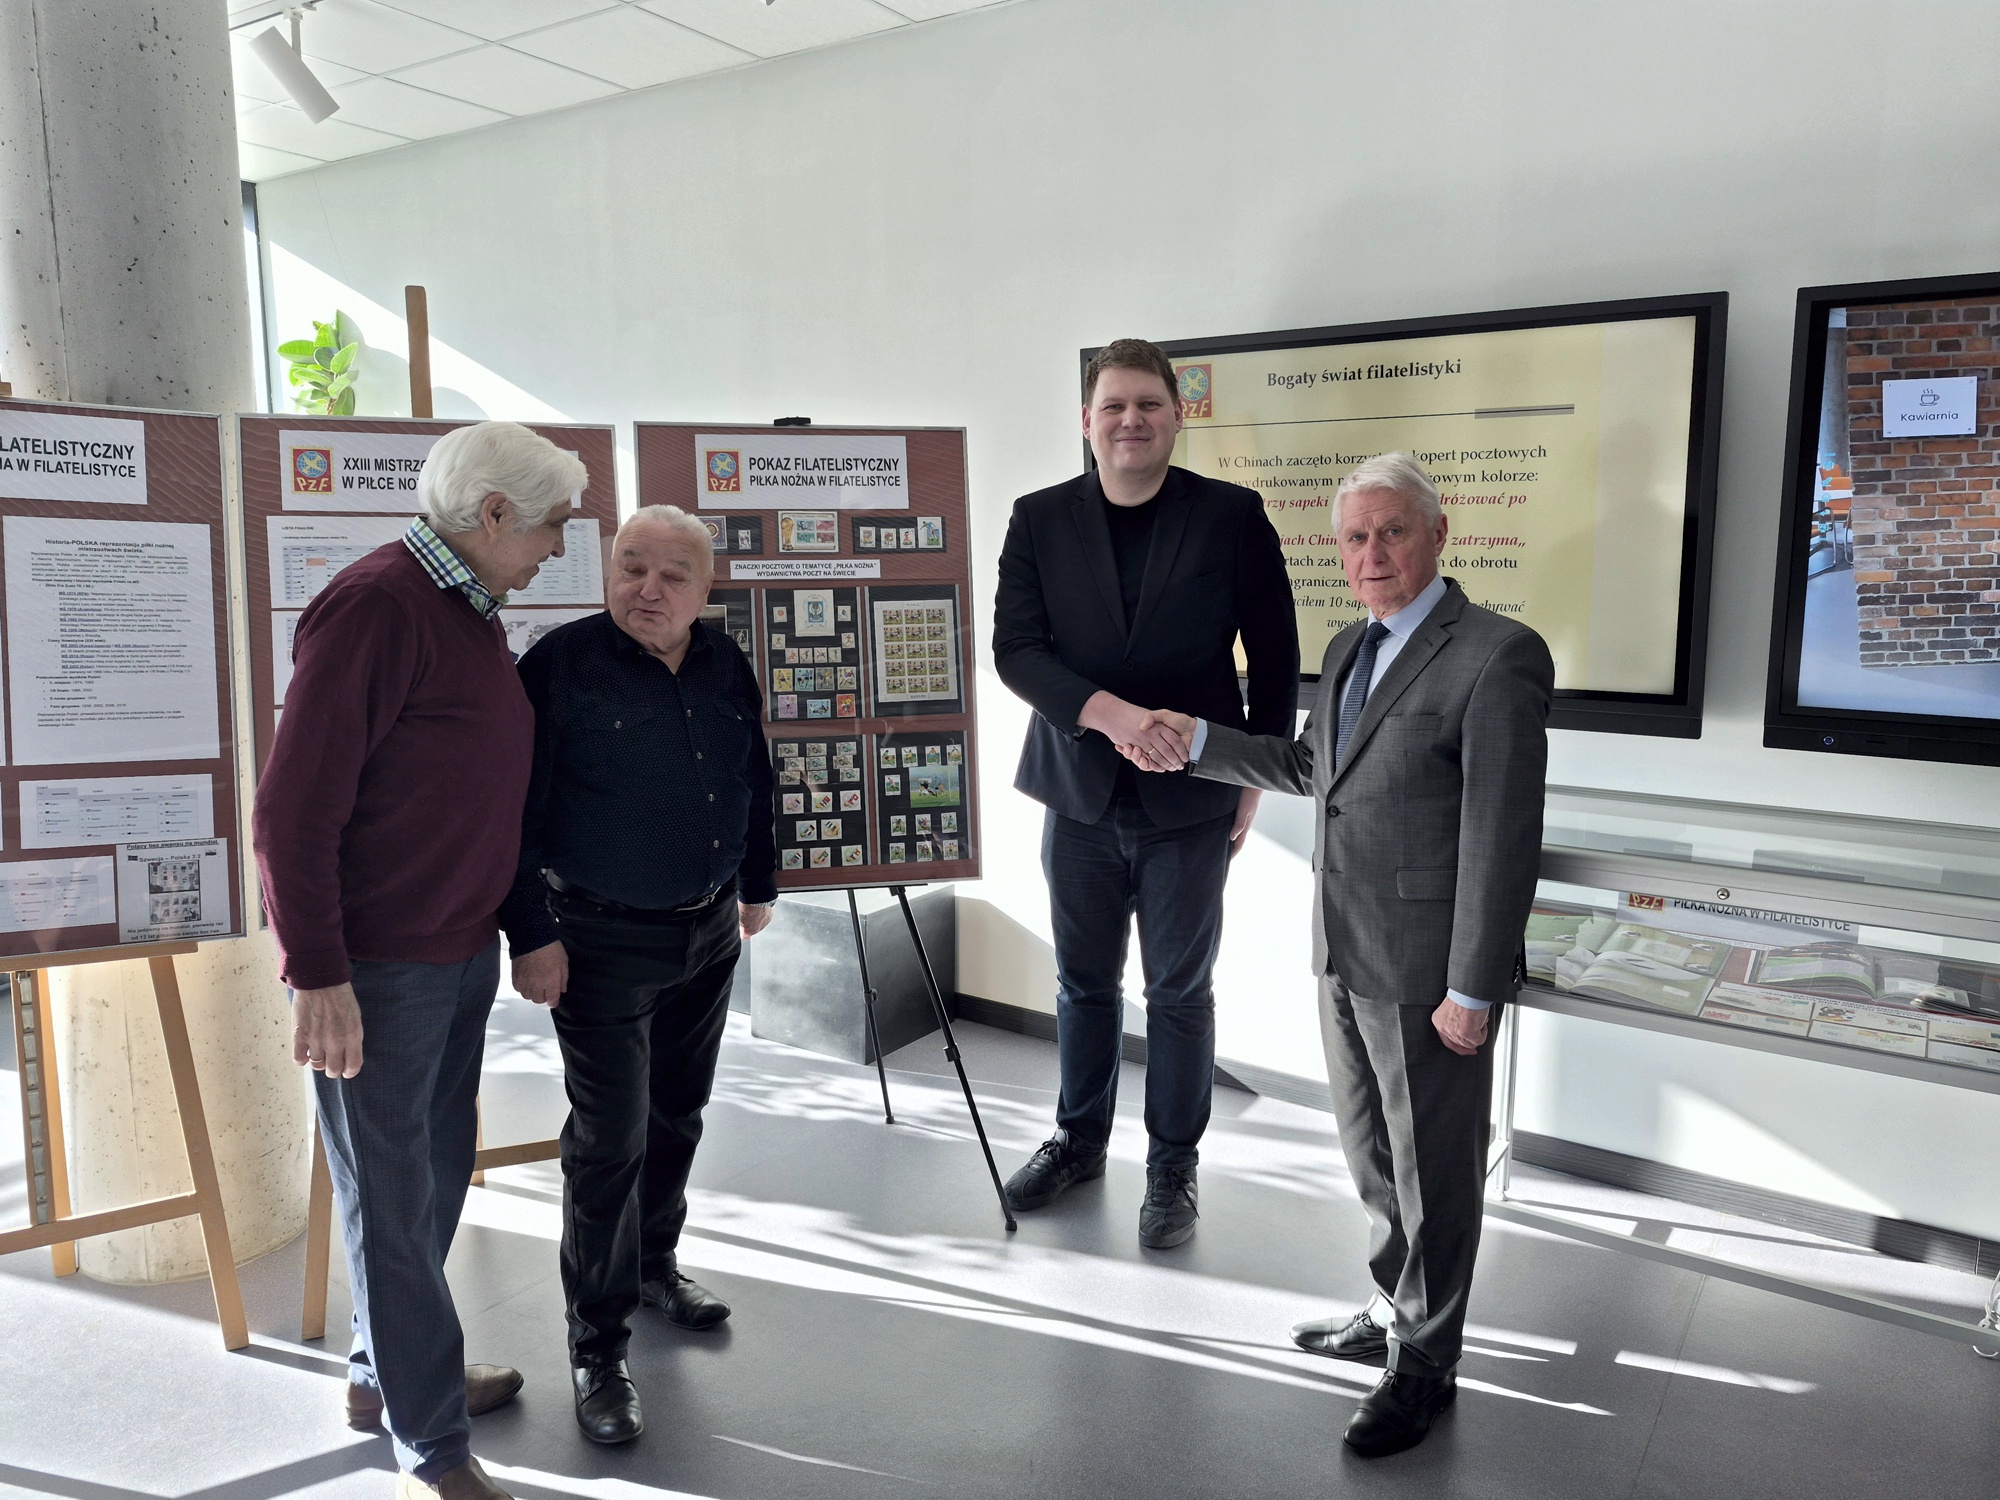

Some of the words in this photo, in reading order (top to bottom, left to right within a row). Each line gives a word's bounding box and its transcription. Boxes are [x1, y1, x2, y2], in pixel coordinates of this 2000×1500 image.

[1267, 371, 1317, 390] Bogaty
[1322, 366, 1362, 382] świat
[1366, 359, 1462, 380] filatelistyki
[1900, 411, 1959, 422] Kawiarnia
[0, 436, 134, 461] LATELISTYCZNY
[1218, 457, 1230, 468] W
[1234, 455, 1283, 468] Chinach
[1286, 454, 1332, 468] zaczęto
[1460, 445, 1547, 464] pocztowych
[16, 458, 30, 472] W
[34, 460, 136, 478] FILATELISTYCE
[343, 458, 370, 471] XXIII
[749, 457, 792, 471] POKAZ
[795, 458, 900, 472] FILATELISTYCZNY
[296, 477, 329, 492] PZF
[342, 476, 354, 489] W
[358, 477, 394, 490] PIŁCE
[398, 478, 419, 490] NO
[710, 478, 738, 491] PZF
[750, 475, 780, 486] PIŁKA
[781, 473, 815, 487] NOŻNA
[816, 475, 827, 486] W
[829, 476, 901, 487] FILATELISTYCE
[1234, 476, 1333, 490] wydrukowanym
[1481, 469, 1539, 483] kolorze:
[1289, 496, 1329, 511] sapeki
[1507, 494, 1527, 508] po
[1308, 534, 1338, 546] Chin
[1318, 556, 1337, 566] zaś
[1450, 556, 1467, 568] do
[1471, 556, 1518, 568] obrotu
[1329, 596, 1342, 608] 10
[1327, 618, 1359, 631] wyso
